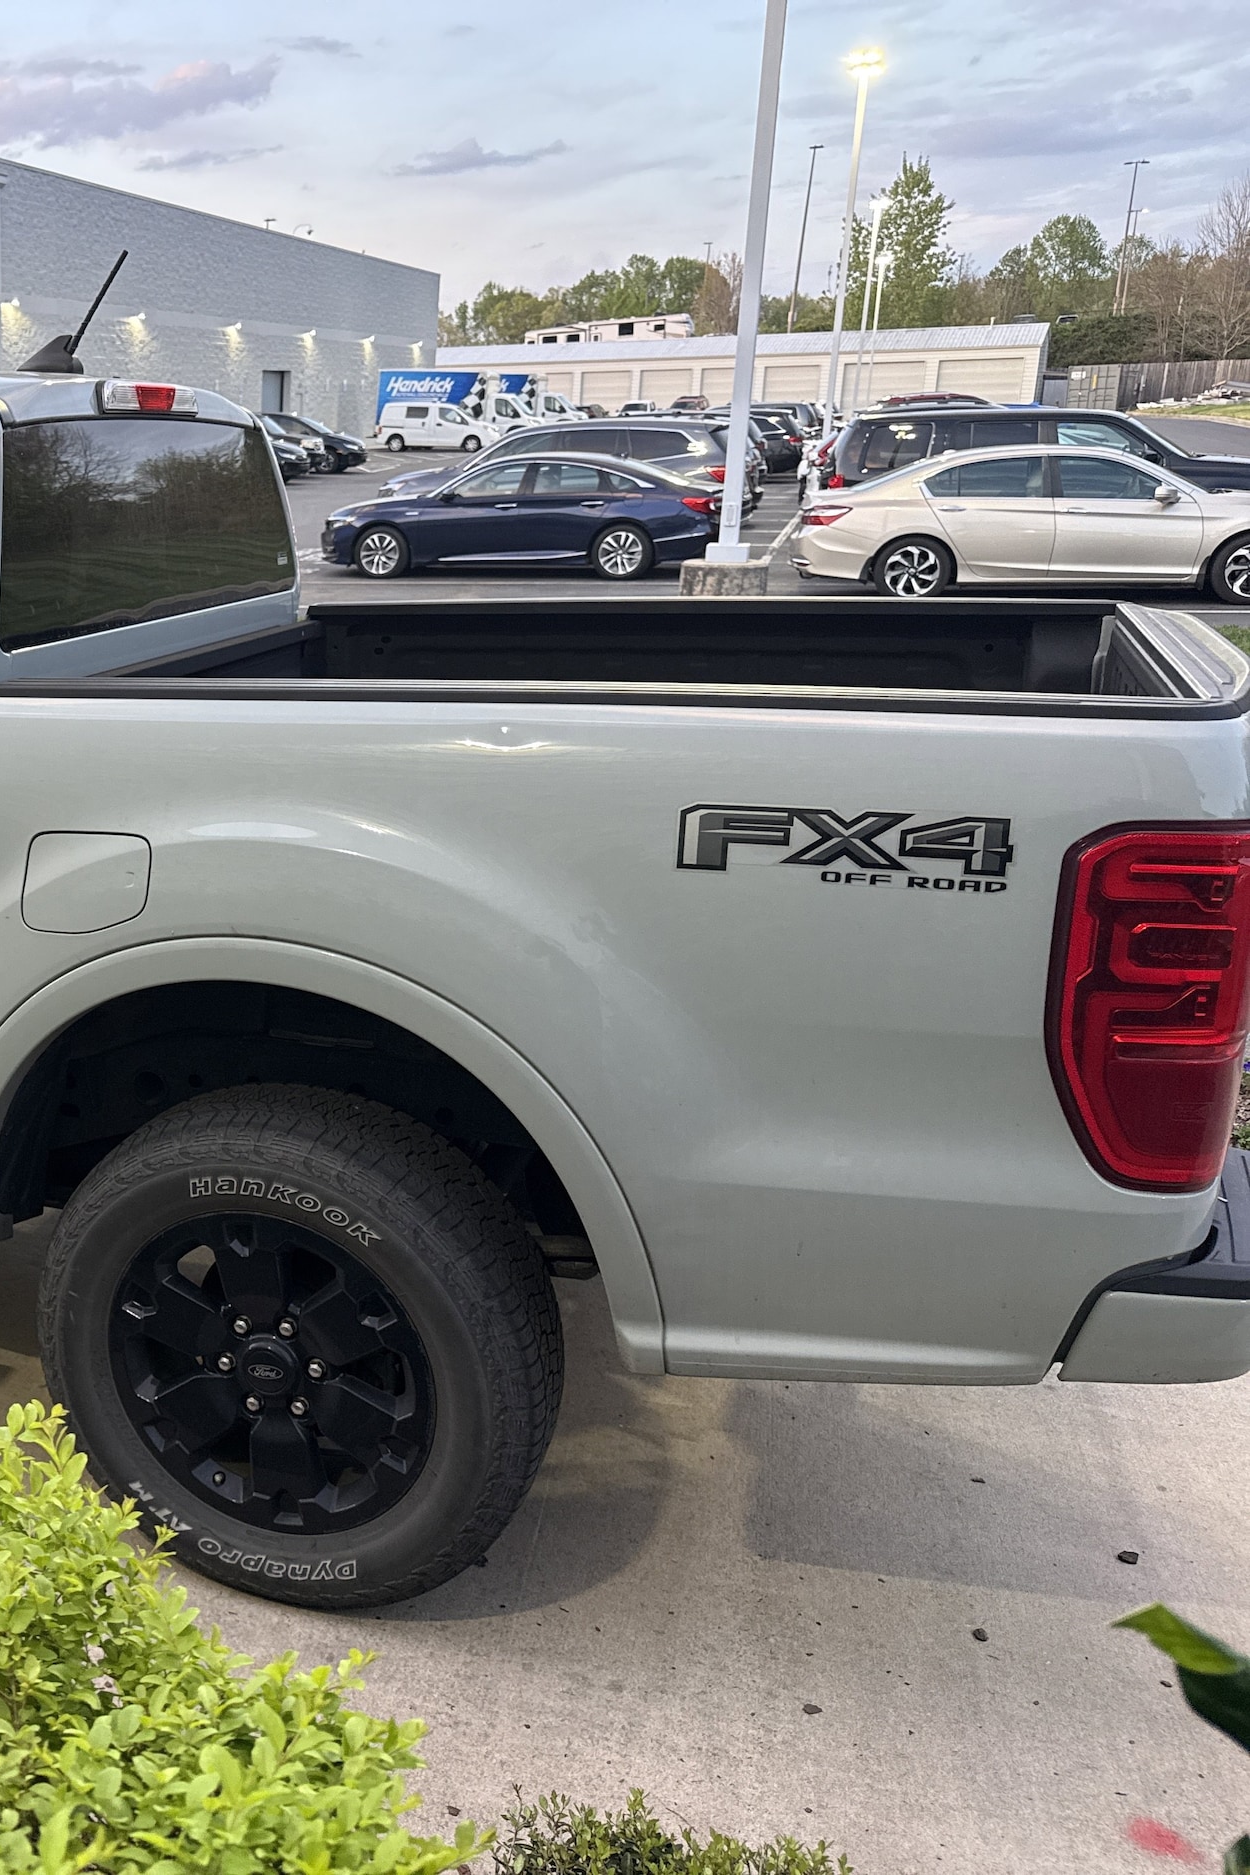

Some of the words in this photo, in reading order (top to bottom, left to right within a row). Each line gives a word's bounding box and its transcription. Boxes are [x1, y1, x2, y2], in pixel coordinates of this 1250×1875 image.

[386, 376, 455, 396] Hendrick
[676, 802, 1014, 877] FX4
[820, 871, 893, 887] OFF
[907, 876, 1007, 893] ROAD
[253, 1366, 278, 1378] Ford
